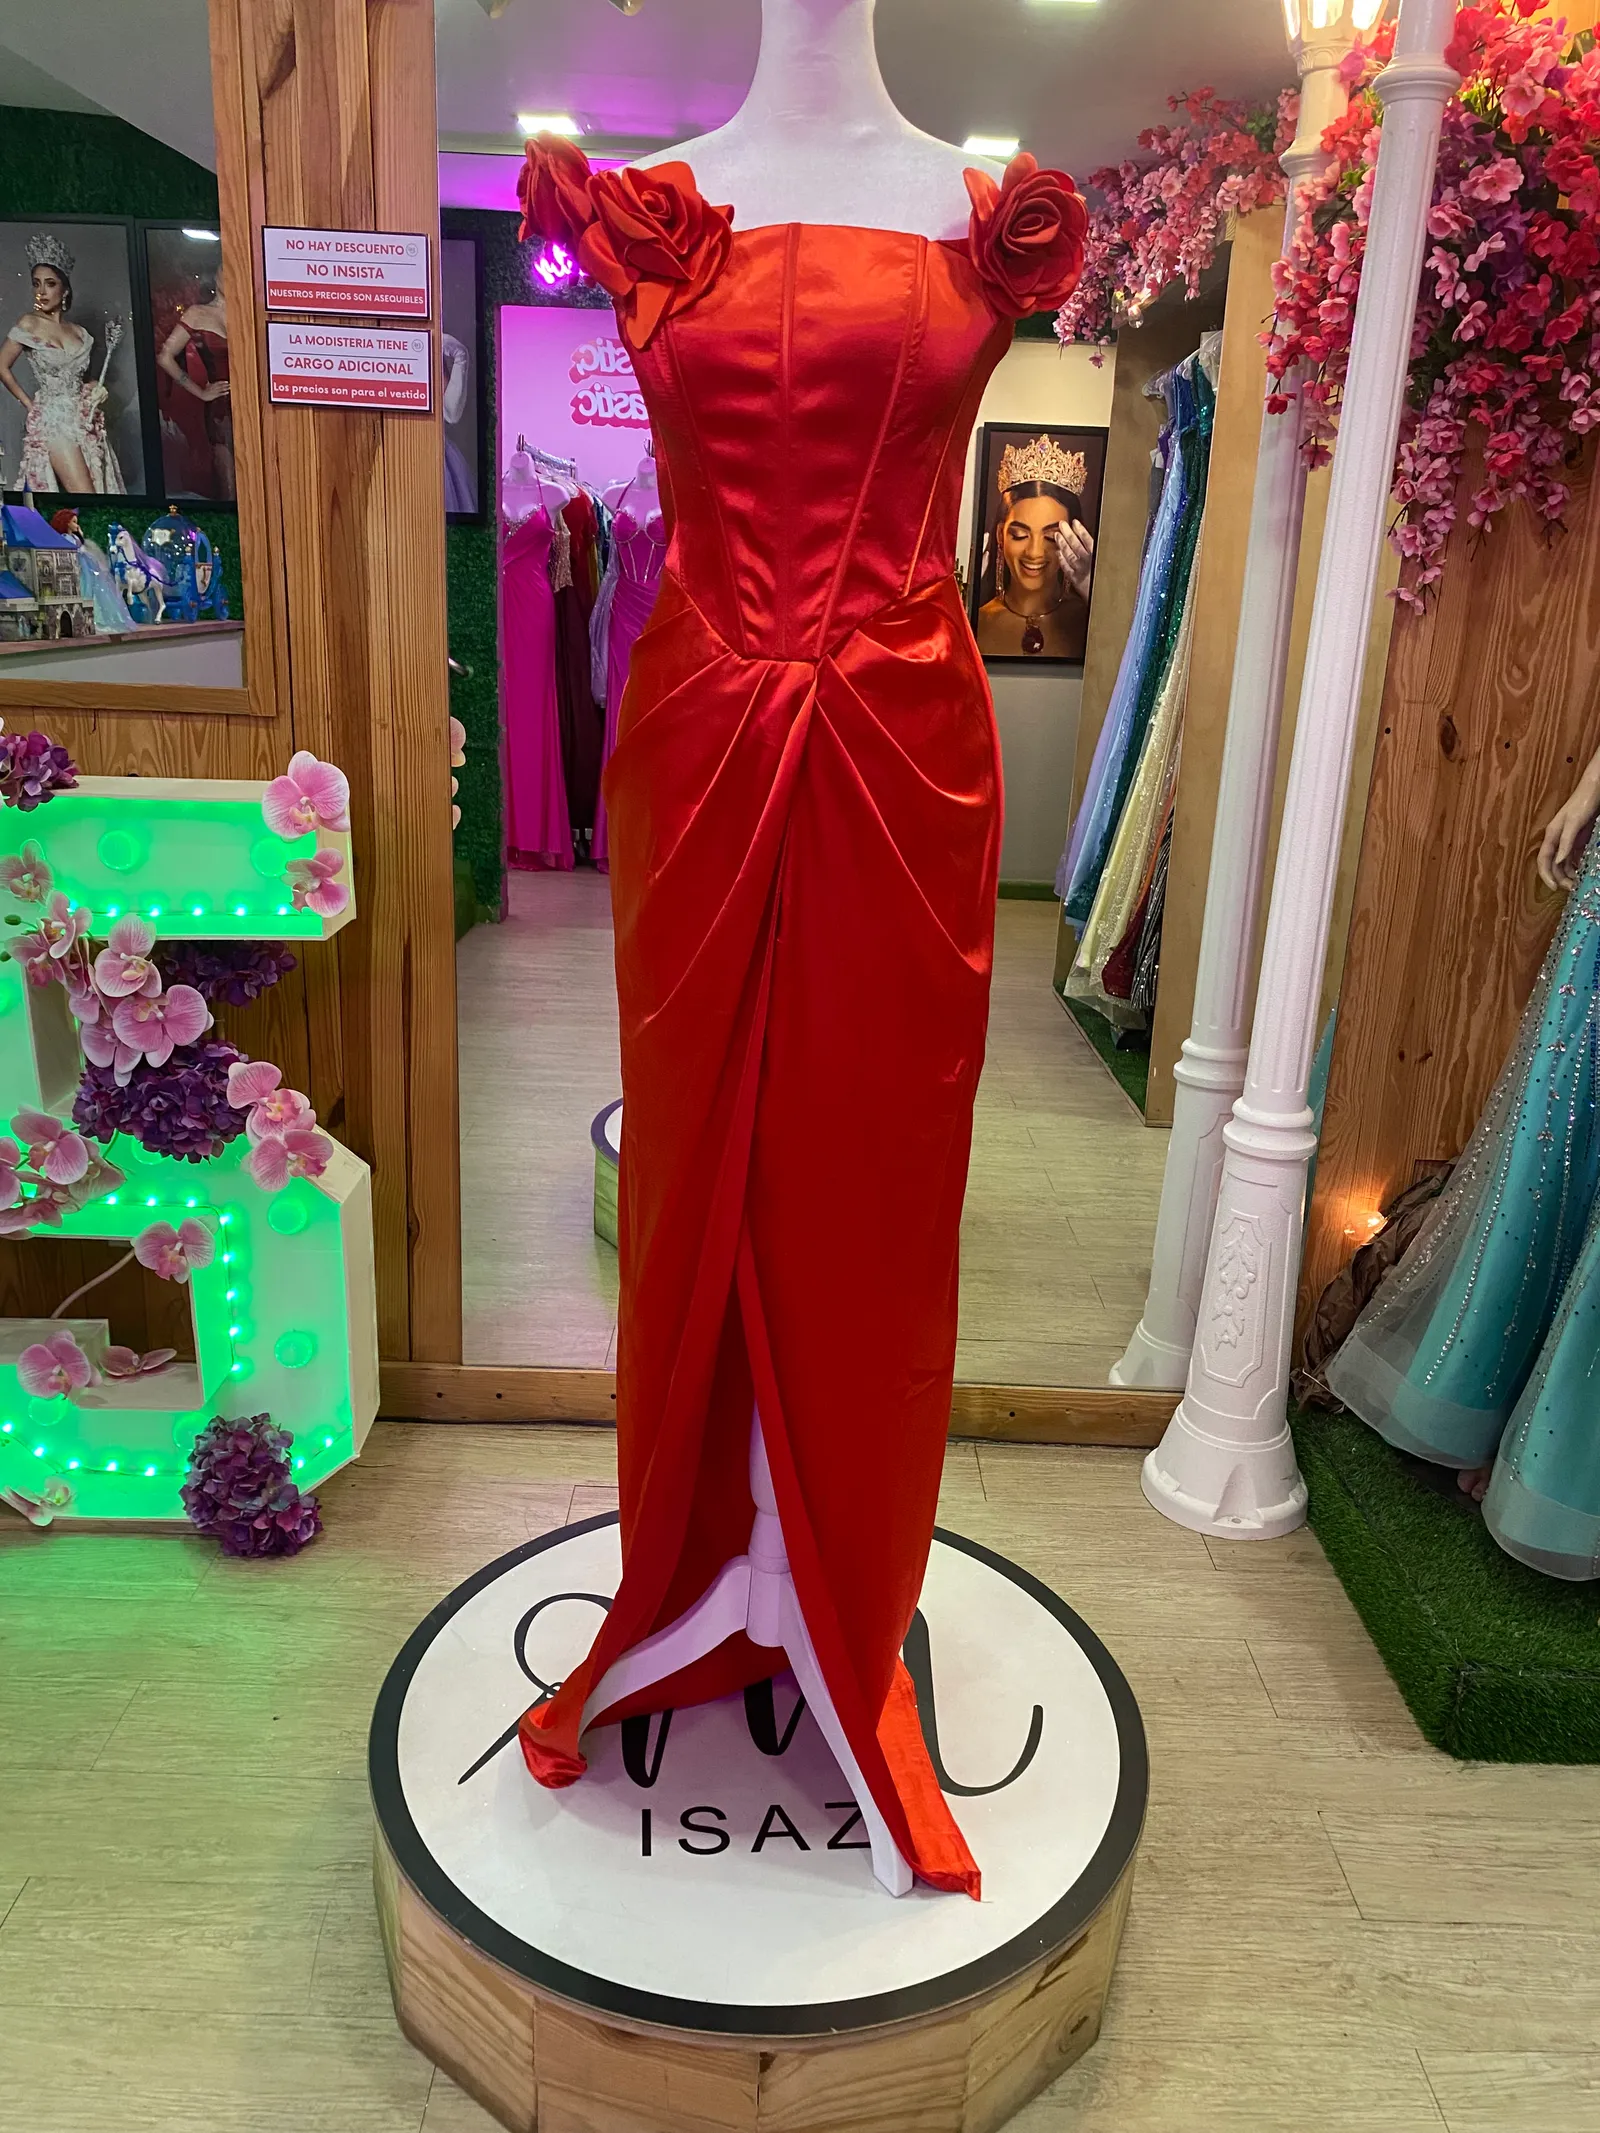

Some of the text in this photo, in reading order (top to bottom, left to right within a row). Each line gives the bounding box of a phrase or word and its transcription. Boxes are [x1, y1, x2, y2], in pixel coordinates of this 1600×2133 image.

[286, 239, 304, 250] NO
[308, 240, 332, 251] HAY
[335, 242, 404, 255] DESCUENTO
[306, 263, 385, 279] NO INSISTA
[269, 288, 424, 305] NUESTROS PRECIOS SON ASEQUIBLES
[289, 334, 302, 345] LA
[305, 335, 374, 349] MODISTERIA
[376, 339, 408, 351] TIENE
[284, 356, 413, 375] CARGO ADICIONAL
[273, 382, 426, 400] Los precios son para el vestido
